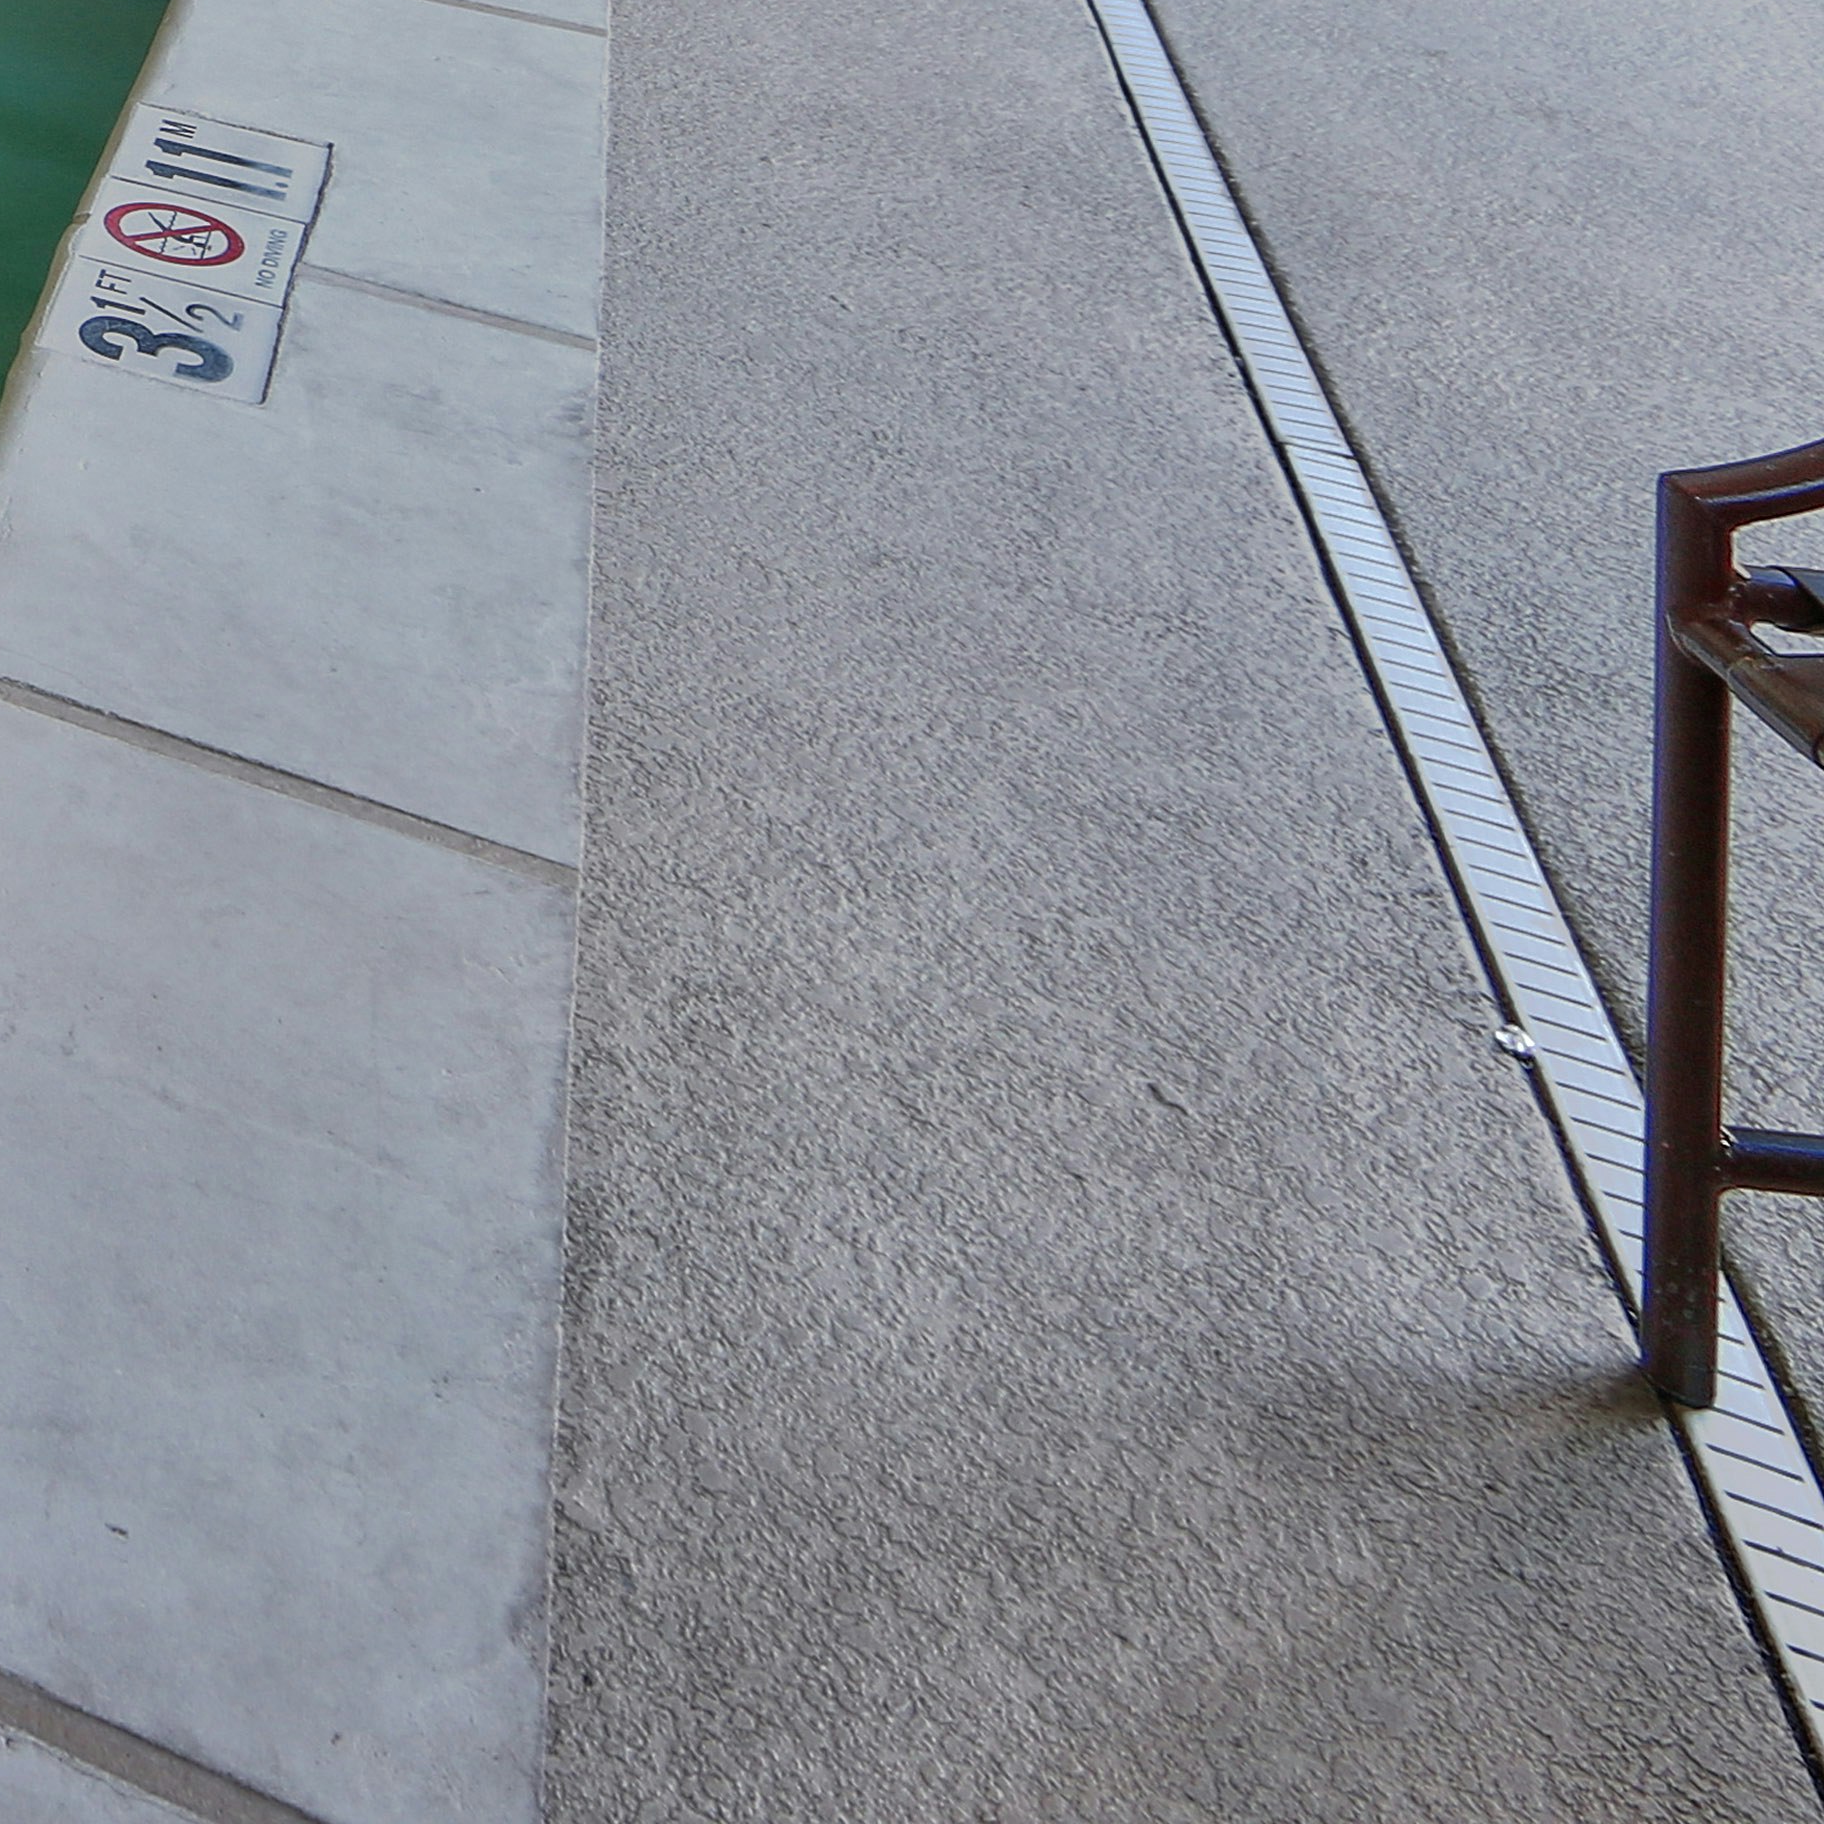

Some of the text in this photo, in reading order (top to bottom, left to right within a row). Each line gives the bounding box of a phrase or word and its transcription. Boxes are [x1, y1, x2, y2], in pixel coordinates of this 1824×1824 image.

[159, 119, 197, 139] M
[255, 229, 289, 289] NO DIVING
[95, 269, 133, 296] FT
